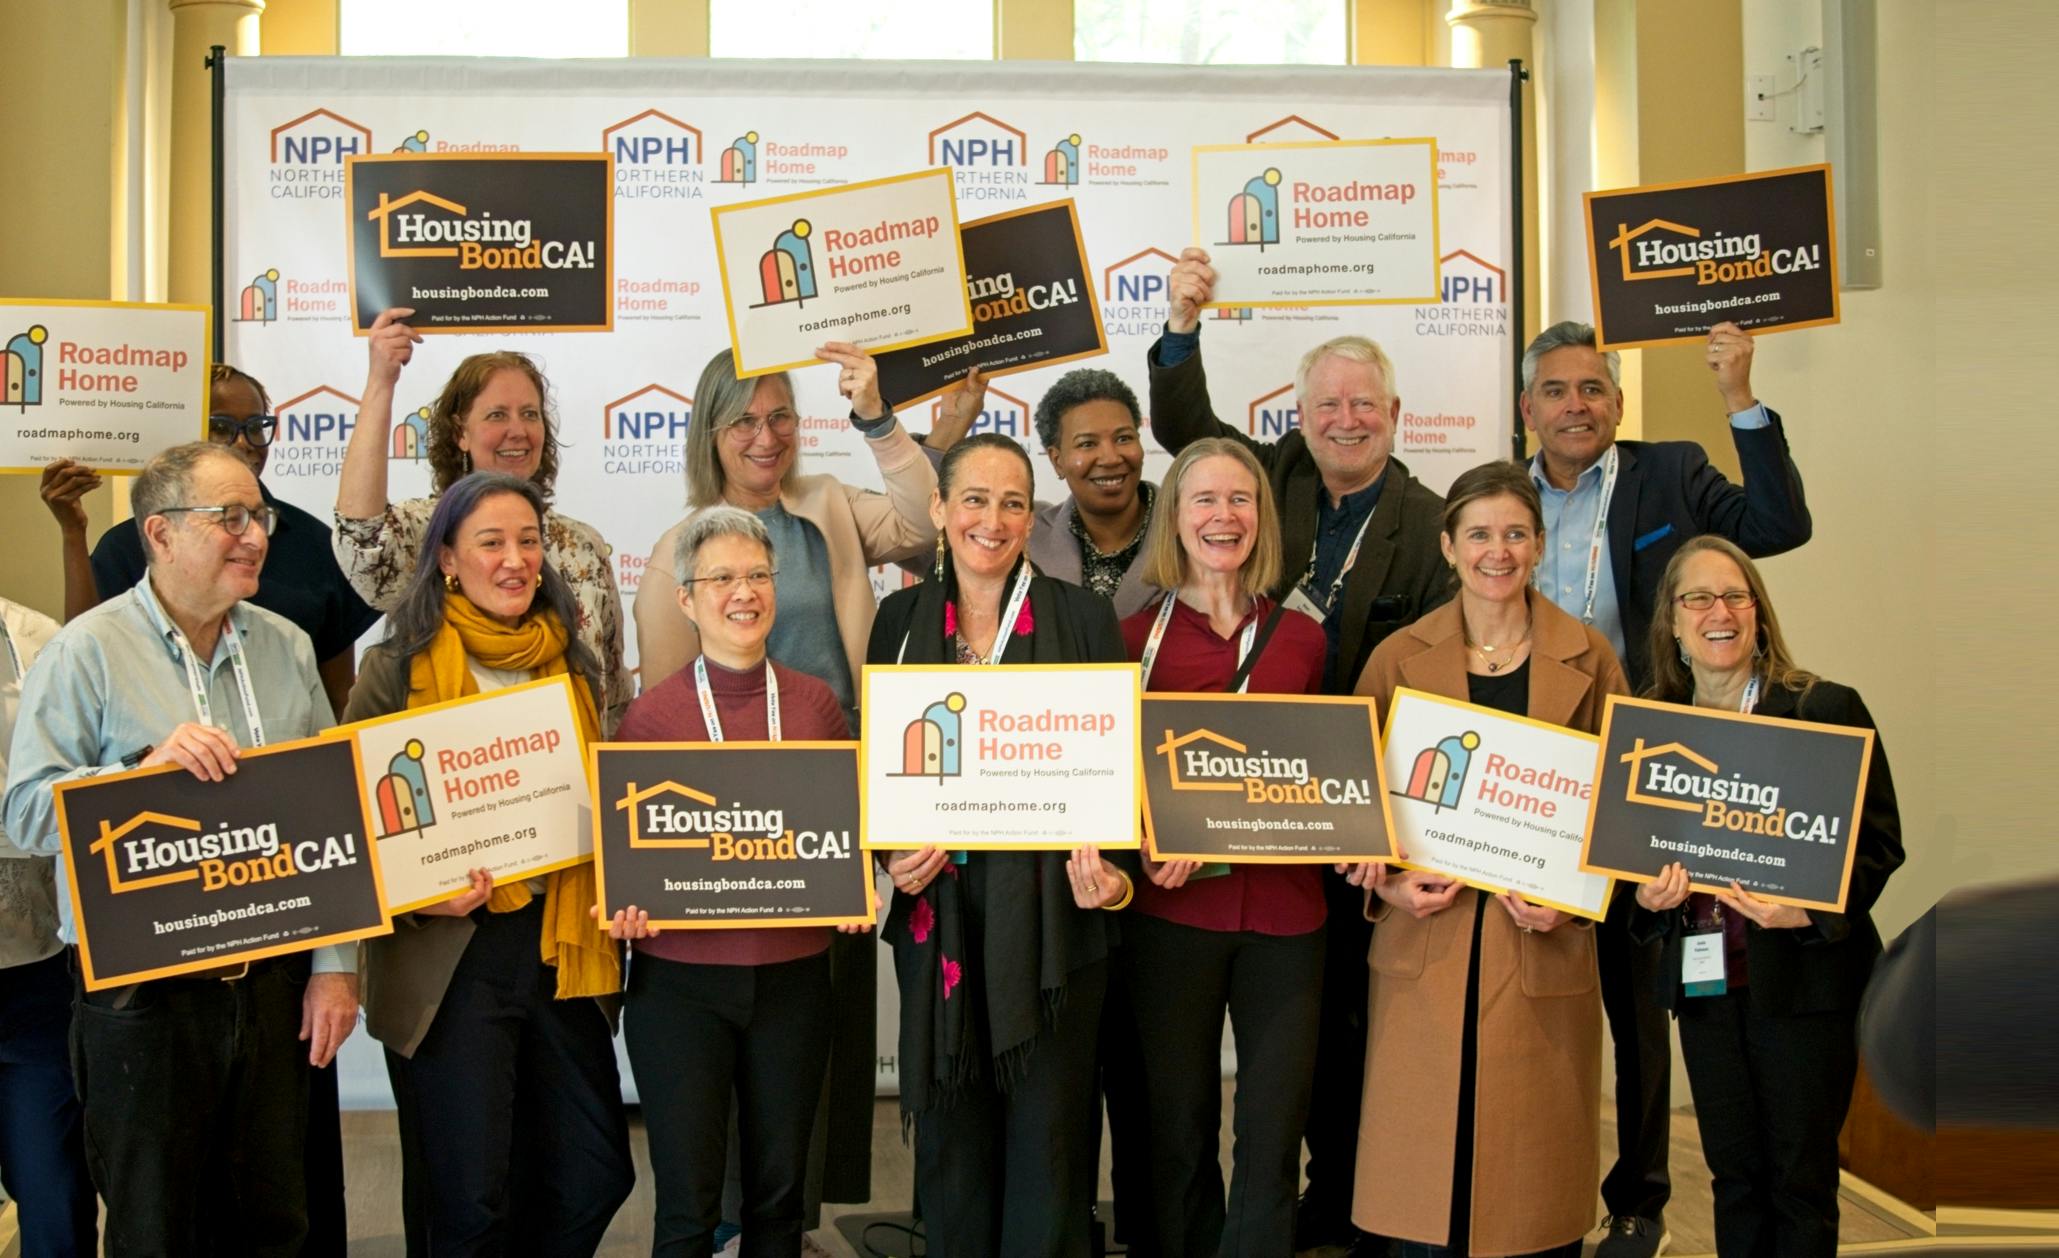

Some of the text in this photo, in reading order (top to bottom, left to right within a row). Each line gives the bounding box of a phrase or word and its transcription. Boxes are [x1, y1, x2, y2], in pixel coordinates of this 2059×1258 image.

[285, 136, 358, 165] NPH
[616, 136, 689, 165] NPH
[765, 142, 848, 159] Roadmap
[942, 139, 1013, 166] NPH
[1088, 144, 1168, 162] Roadmap
[270, 169, 345, 183] NORTHE
[616, 169, 703, 183] ORTHERN
[765, 160, 816, 174] Home
[956, 171, 1028, 185] RTHERN
[1088, 162, 1137, 176] Home
[271, 185, 344, 199] CALIFOR
[614, 185, 703, 199] ALIFORNIA
[1292, 181, 1416, 204] Roadmap
[397, 212, 531, 249] Housing
[1294, 207, 1369, 229] Home
[824, 216, 939, 252] Roadmap
[1296, 232, 1416, 245] Powered by Housing California
[460, 239, 595, 270] BondCA!
[1636, 231, 1760, 267] Housing
[828, 250, 901, 278] Home
[1258, 262, 1375, 276] roadmaphome.org
[1697, 244, 1820, 286] BondCA!
[287, 279, 347, 294] Roadm
[618, 279, 700, 295] Roadmap
[834, 266, 944, 293] Powered by Housing California
[1118, 275, 1170, 302] NP
[287, 297, 337, 312] Home
[412, 286, 549, 301] housingbondca.com
[618, 297, 668, 311] Home
[970, 279, 1078, 322] ondCA!
[1655, 291, 1781, 315] housingbondca.com
[799, 303, 911, 332] roadmaphome.org
[1104, 307, 1169, 320] NORTH
[1415, 308, 1507, 321] NORTHERN
[1105, 323, 1161, 336] CALIFO
[1416, 323, 1506, 336] CALIFORNIA
[59, 342, 188, 372] Roadmap
[922, 327, 1043, 367] housingbondca.com
[59, 369, 138, 392] Home
[59, 398, 185, 410] Powered by Housing California
[618, 412, 689, 439] NPH
[801, 416, 850, 432] dmap
[970, 410, 1016, 437] PH
[1261, 409, 1300, 436] NP
[1403, 413, 1476, 430] Roadmap
[17, 428, 140, 443] roadmaphome.org
[1403, 431, 1447, 445] Home
[604, 445, 686, 458] NORTHE
[604, 461, 686, 474] CALIFORN
[979, 708, 1115, 736] Roadmap
[438, 728, 561, 775] Roadmap
[979, 737, 1063, 761] Home
[980, 767, 1115, 779] Powered by Housing California
[1184, 750, 1309, 784] Housing
[1484, 753, 1593, 800] Roadma
[443, 769, 521, 804] Home
[1244, 777, 1371, 805] BondCA!
[1477, 779, 1557, 819] Home
[1646, 762, 1779, 814] Housing
[451, 783, 571, 820] Powered by Housing California
[935, 801, 1067, 813] roadmaphome.org
[646, 802, 783, 839] Housing
[1206, 818, 1334, 832] housingbondca.com
[1473, 807, 1583, 844] Powered by Housing Califo
[1702, 799, 1840, 845] BondCA!
[124, 822, 279, 874] Housing
[421, 826, 537, 866] roadmaphome.org
[711, 830, 850, 861] BondCA!
[1425, 828, 1546, 869] roadmaphome.org
[1650, 835, 1786, 867] housingbondca.com
[199, 834, 357, 892] BondCA!
[664, 878, 806, 893] housingbondca.com
[153, 895, 312, 935] housingbondca.com
